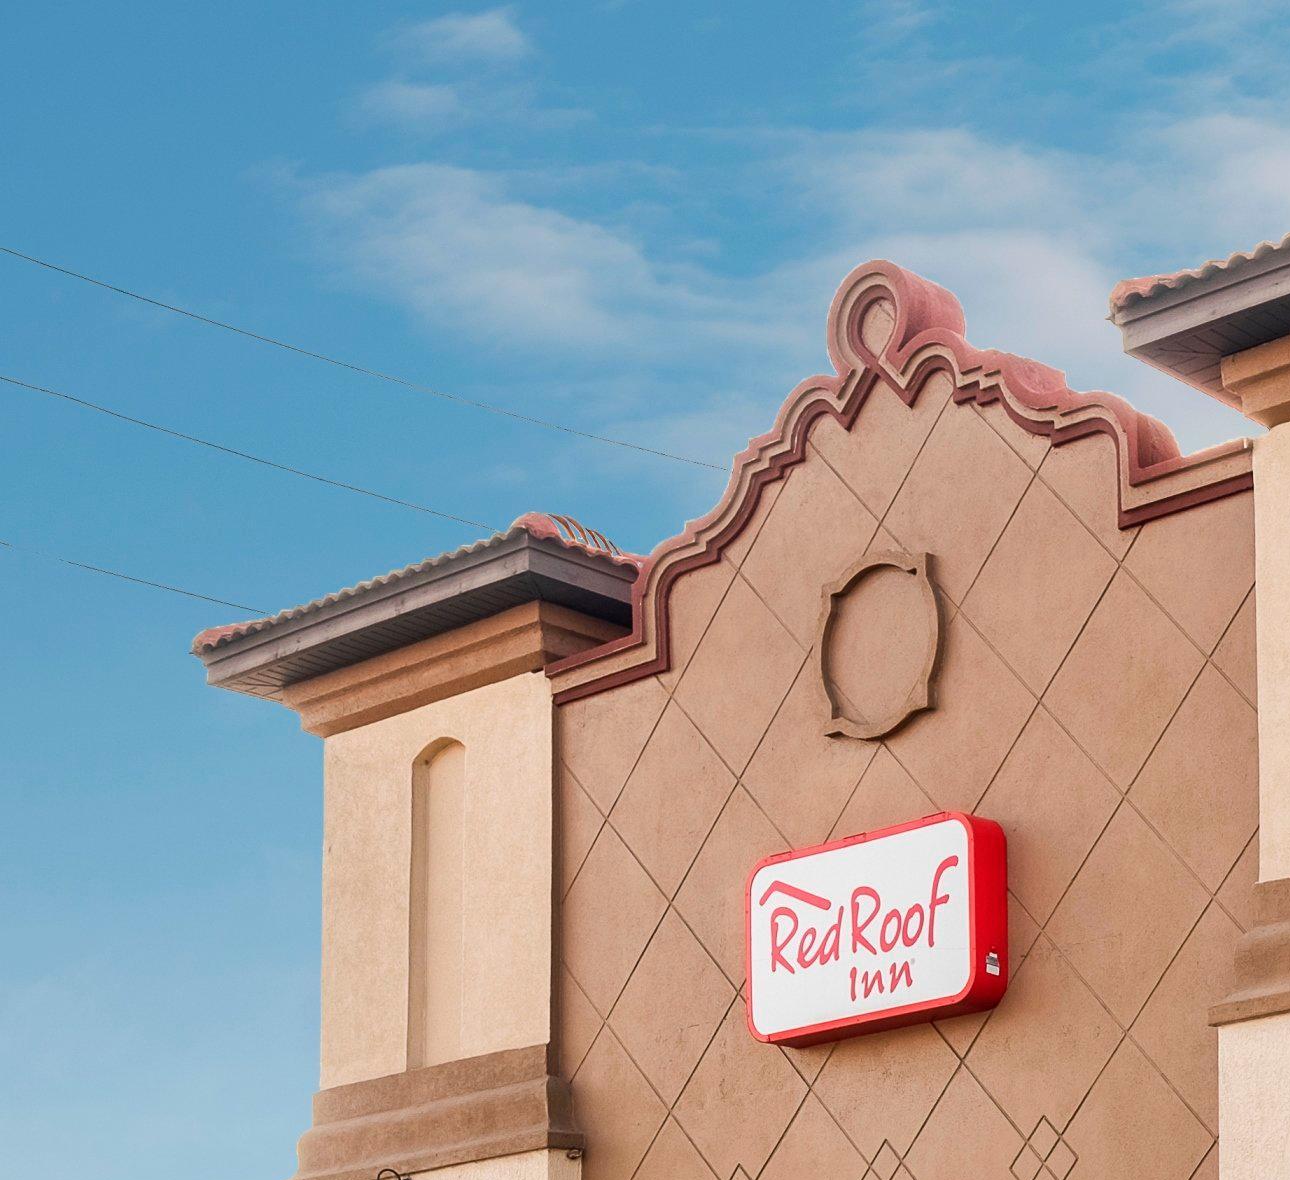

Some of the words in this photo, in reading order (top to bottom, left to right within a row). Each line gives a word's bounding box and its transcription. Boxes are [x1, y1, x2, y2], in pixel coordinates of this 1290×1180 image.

[771, 905, 845, 974] Red
[851, 855, 959, 955] Roof
[850, 960, 913, 1001] Inn
